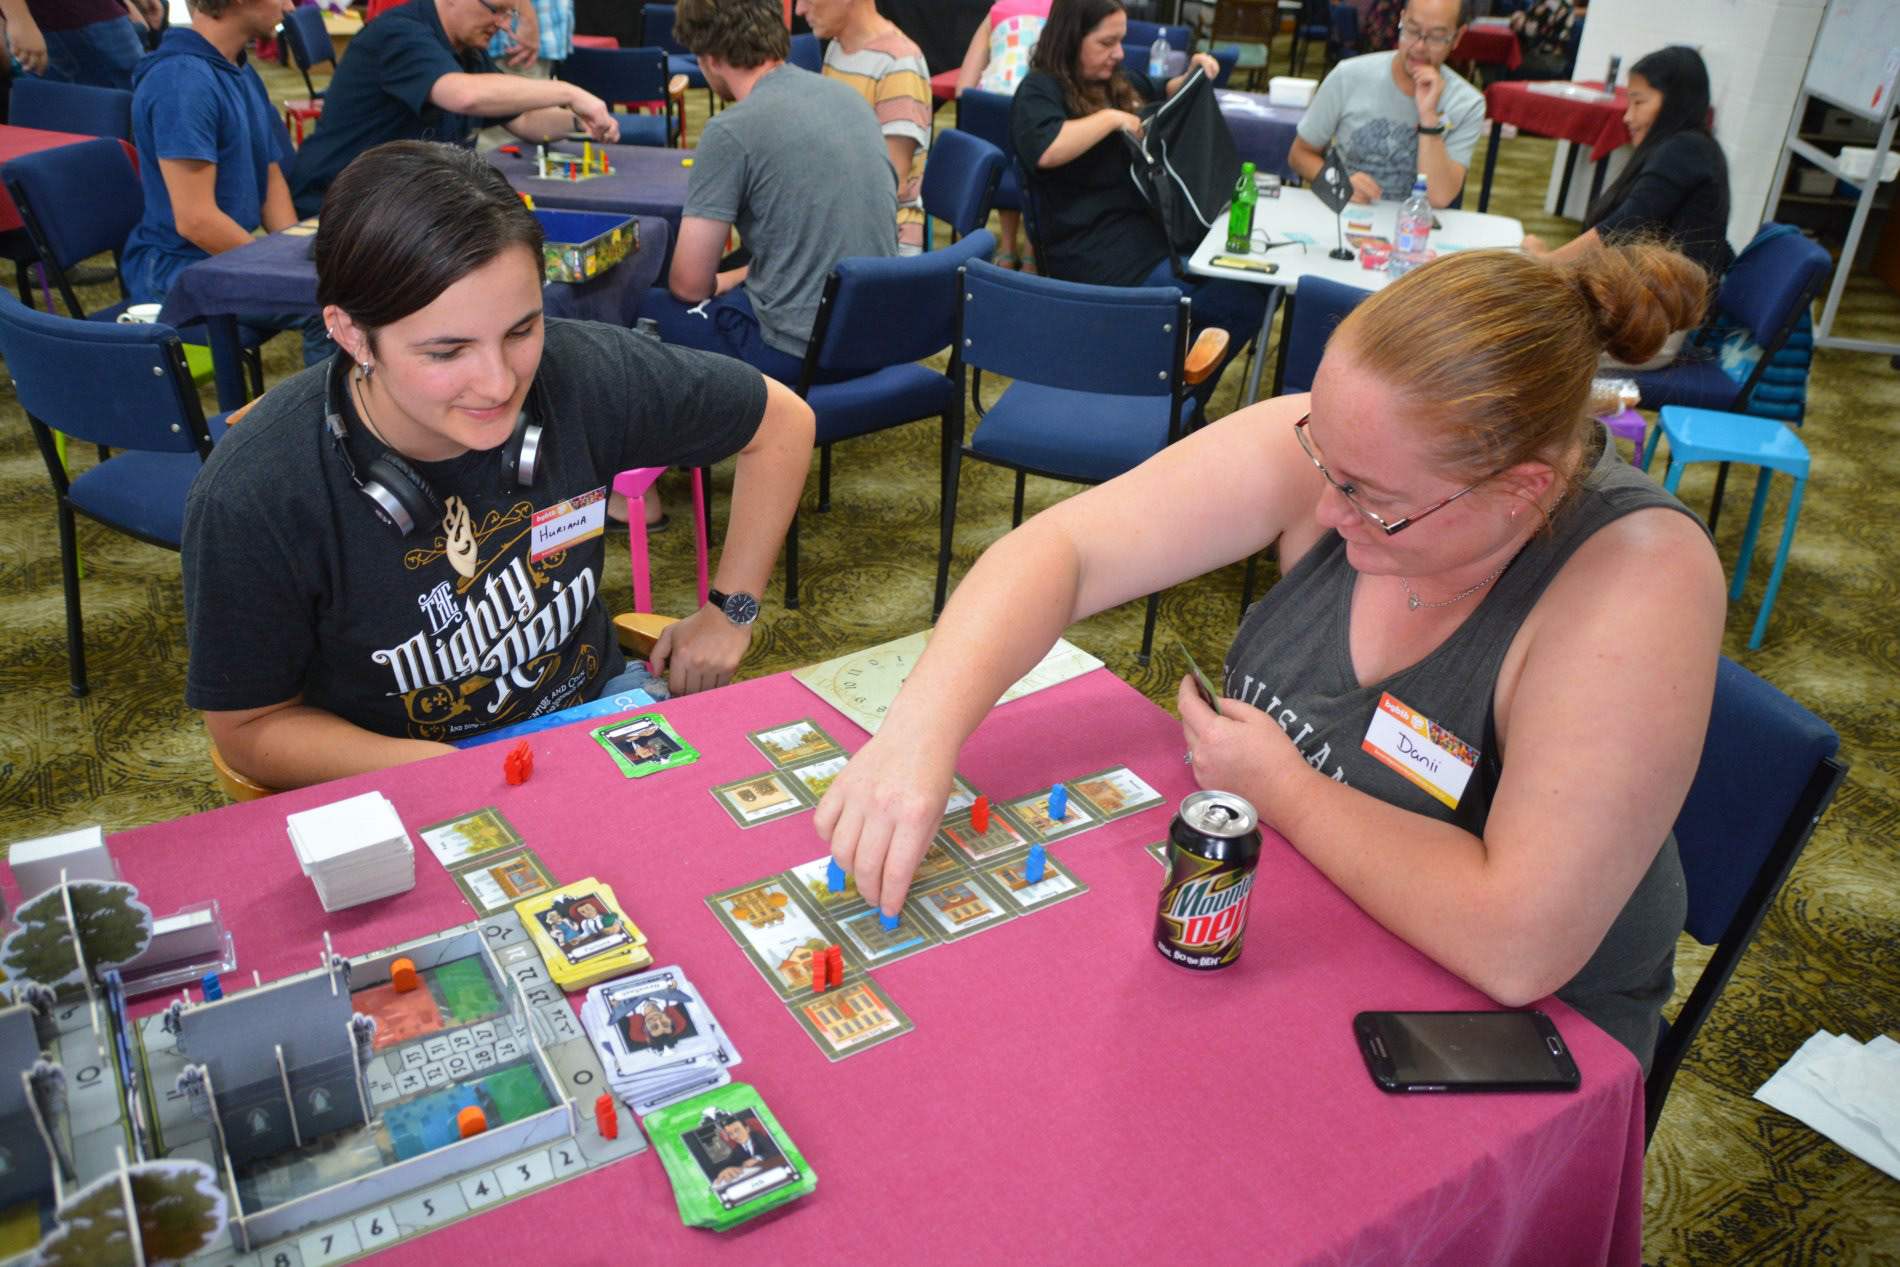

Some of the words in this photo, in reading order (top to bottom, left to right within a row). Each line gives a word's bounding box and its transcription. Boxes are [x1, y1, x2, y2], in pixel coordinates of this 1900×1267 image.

[371, 556, 536, 696] Mighty
[1384, 699, 1409, 720] bgbtb
[1397, 731, 1442, 773] Danii
[560, 1151, 573, 1166] 2
[517, 1165, 530, 1181] 3
[476, 1180, 489, 1196] 4
[423, 1199, 434, 1216] 5
[370, 1218, 383, 1235] 6
[320, 1234, 333, 1254] 7
